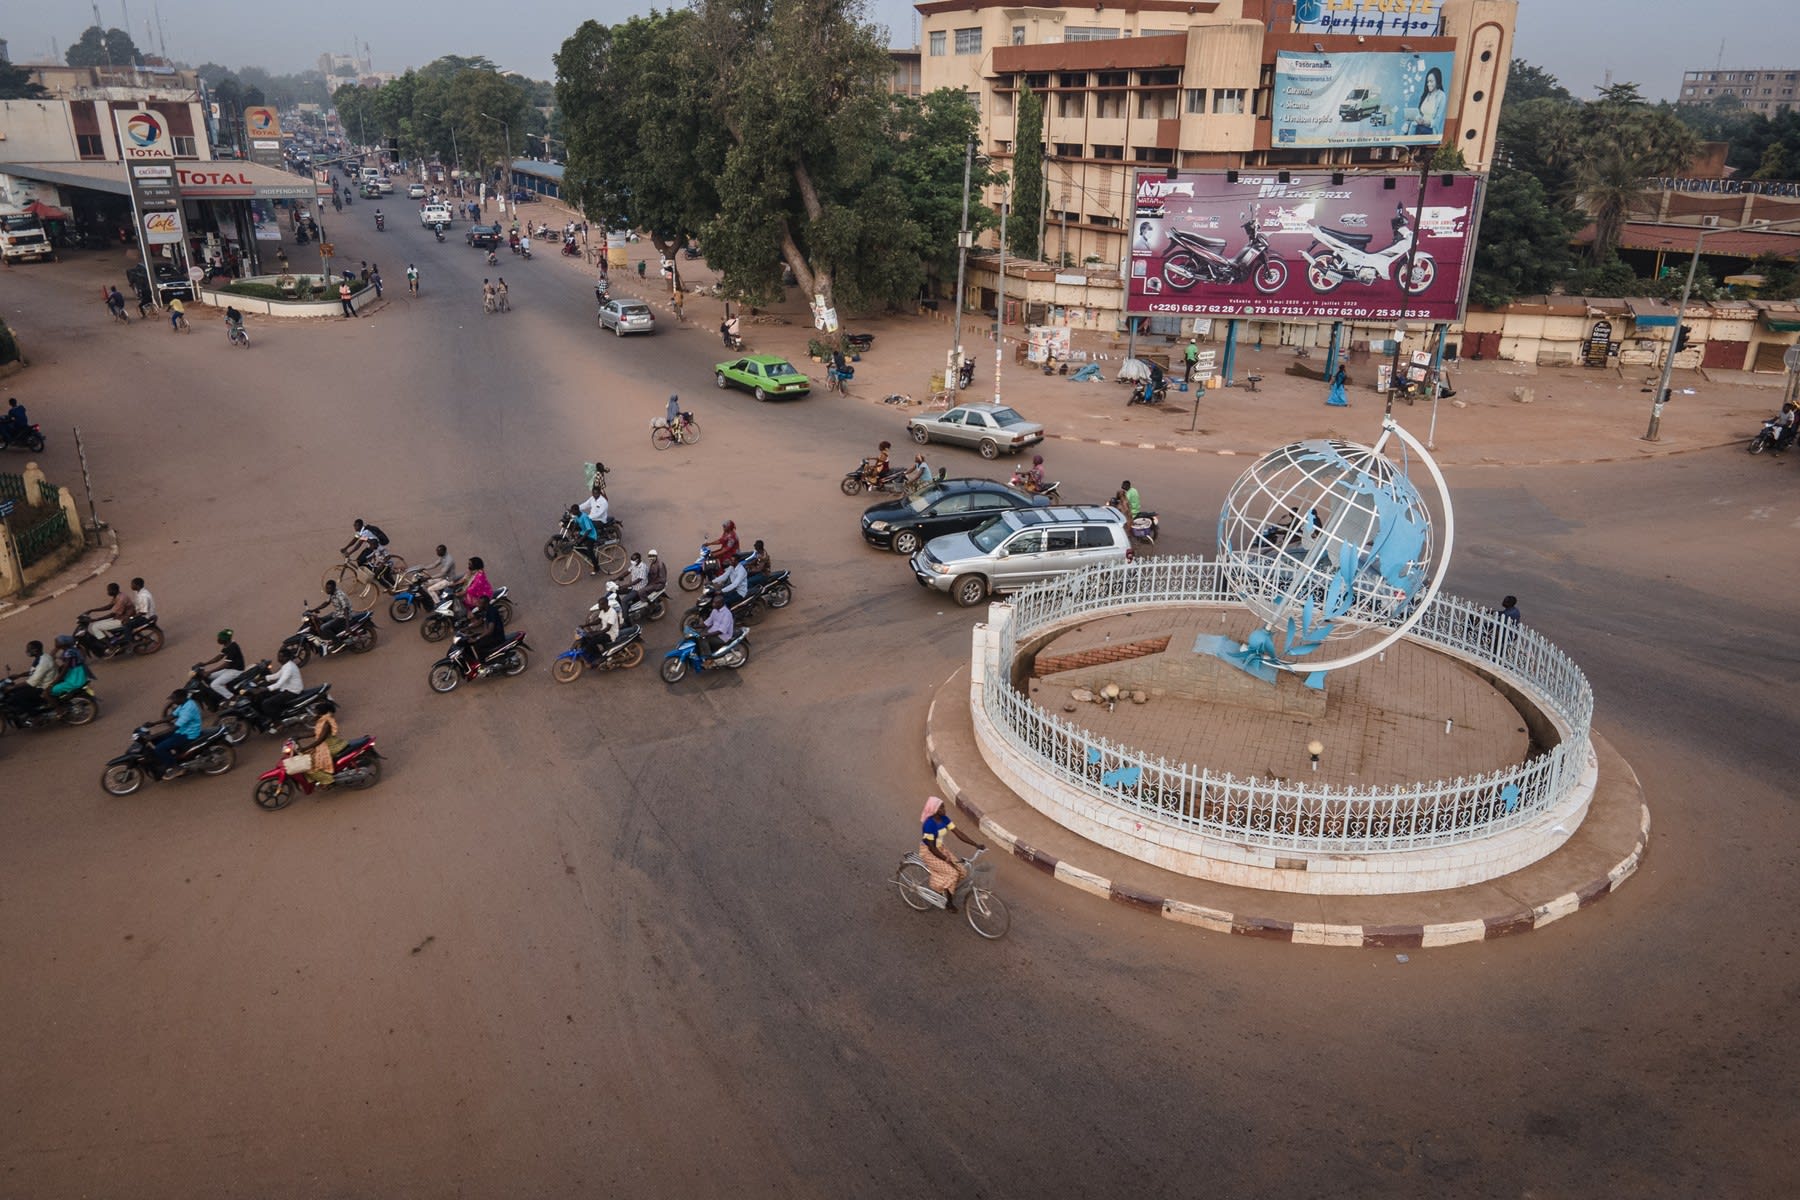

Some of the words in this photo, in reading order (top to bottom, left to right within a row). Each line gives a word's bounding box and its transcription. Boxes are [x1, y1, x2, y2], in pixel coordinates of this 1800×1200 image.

[1321, 15, 1384, 28] Burkina
[1392, 18, 1429, 29] Faso
[127, 148, 171, 157] TOTAL
[176, 169, 252, 184] TOTAL
[1317, 191, 1352, 199] PRIX
[1149, 303, 1180, 312] (+226)
[1182, 304, 1193, 312] 66
[1195, 304, 1208, 312] 27
[1208, 304, 1220, 312] 62
[1222, 305, 1234, 313] 28
[1268, 306, 1280, 314] 16
[1282, 307, 1303, 315] 7131
[1313, 307, 1325, 315] 70
[1340, 308, 1352, 316] 62
[1354, 308, 1366, 316] 00
[1390, 309, 1401, 317] 34
[1418, 310, 1430, 318] 32
